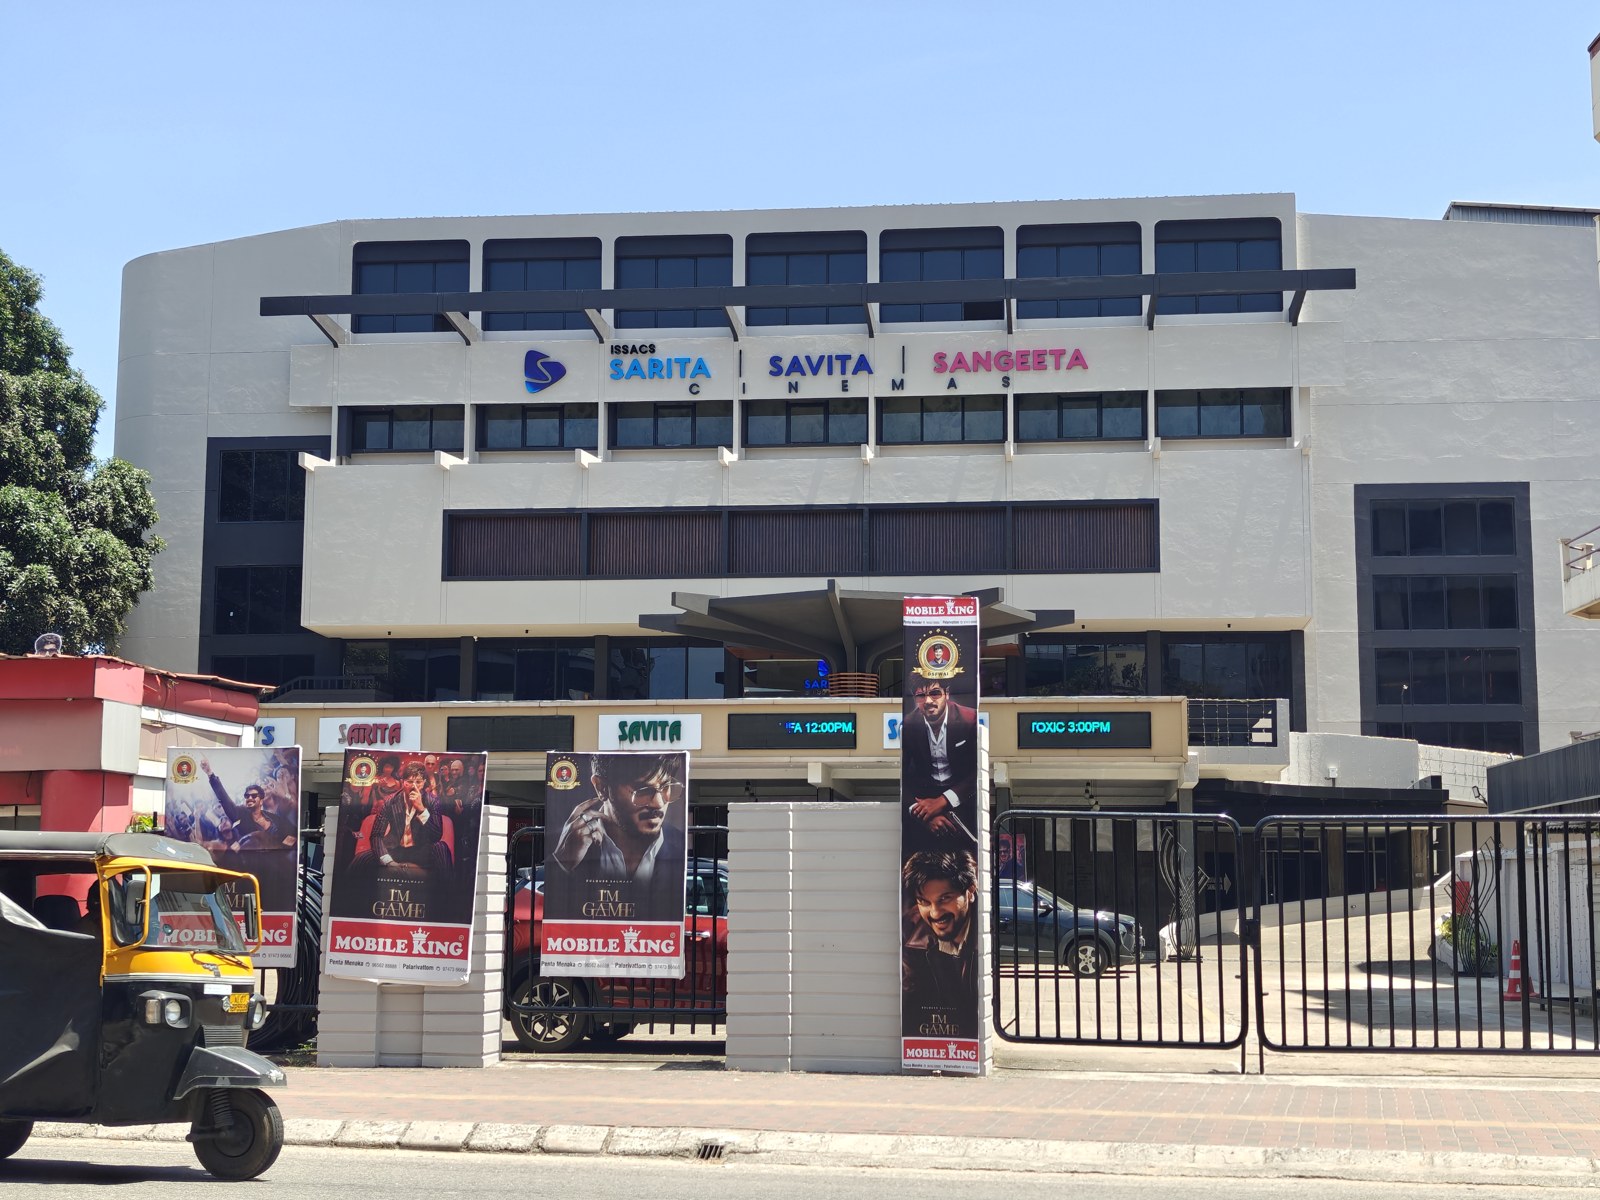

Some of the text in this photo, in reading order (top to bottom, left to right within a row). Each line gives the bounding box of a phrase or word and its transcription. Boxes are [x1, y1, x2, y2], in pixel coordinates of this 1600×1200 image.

[610, 344, 656, 355] ISSACS
[609, 348, 1089, 380] SARITA SAVITA SANGEETA
[905, 605, 974, 615] MOBILE KING
[338, 723, 402, 746] SARITA
[618, 720, 682, 744] SAVITA
[1067, 721, 1111, 734] 3:00PM
[372, 901, 426, 918] GAME
[582, 902, 635, 918] GAME
[335, 935, 464, 956] MOBILE KING
[546, 937, 675, 954] MOBILE KING
[331, 958, 345, 966] Penta
[346, 959, 366, 967] Menaka
[402, 963, 434, 971] Palarivattom
[919, 1023, 959, 1036] GAME
[906, 1048, 976, 1060] MOBILE KING
